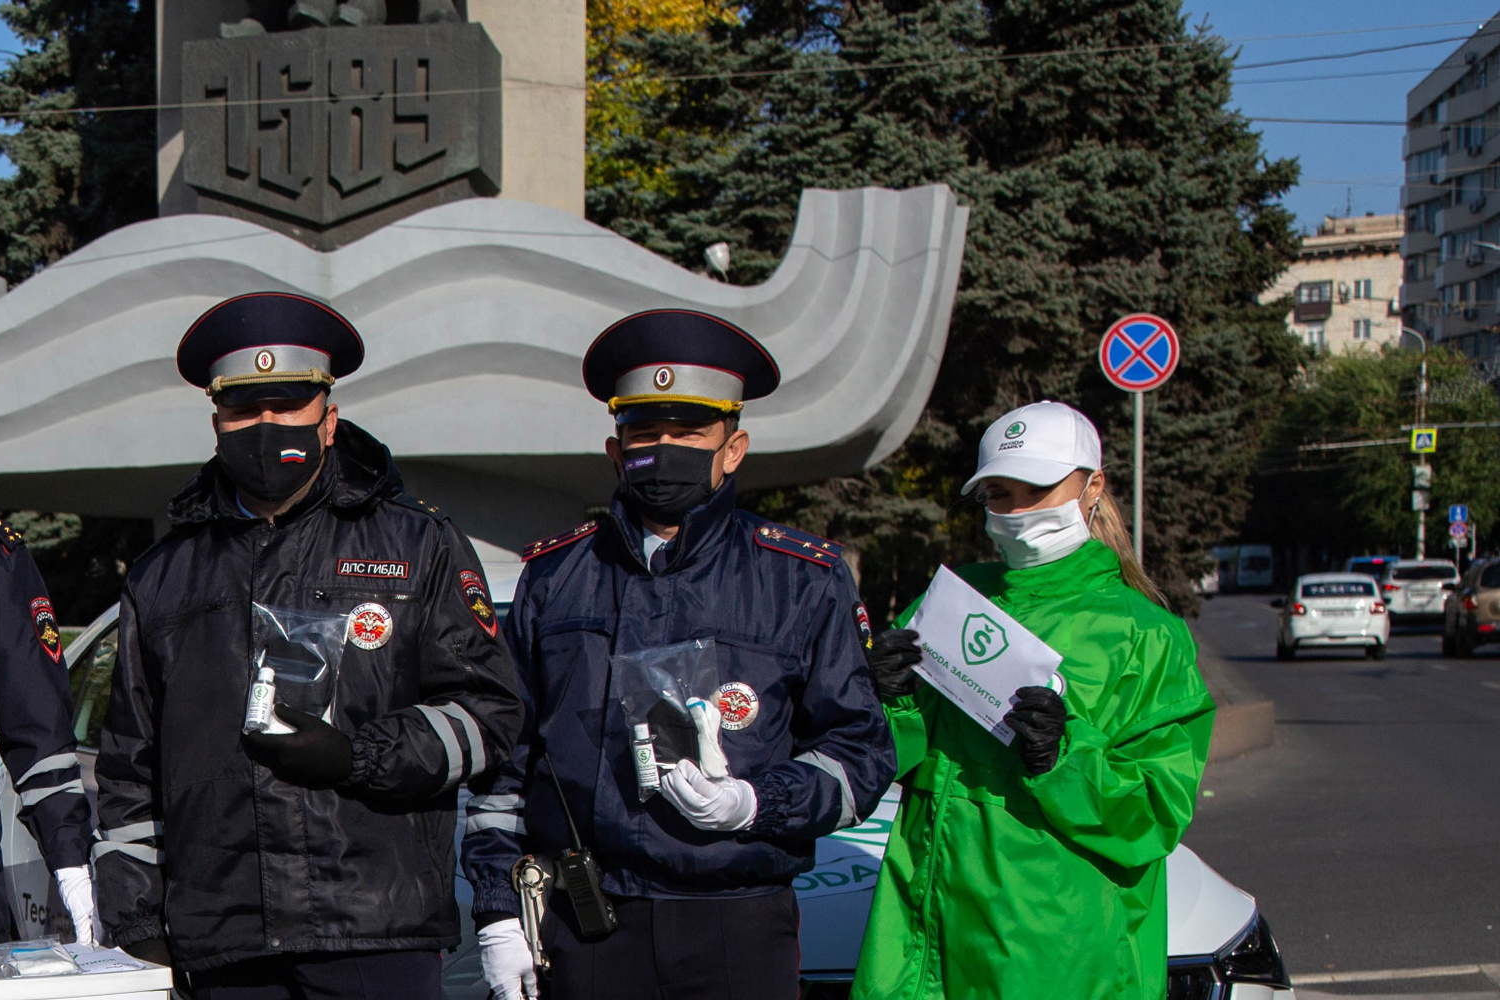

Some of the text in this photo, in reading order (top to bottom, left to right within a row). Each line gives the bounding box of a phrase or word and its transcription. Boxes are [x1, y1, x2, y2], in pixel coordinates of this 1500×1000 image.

[341, 562, 404, 577] ДПС ГИБДД
[968, 623, 995, 658] Š
[950, 666, 1002, 709] ЗАБОТИТСЯ
[793, 864, 880, 891] ODA
